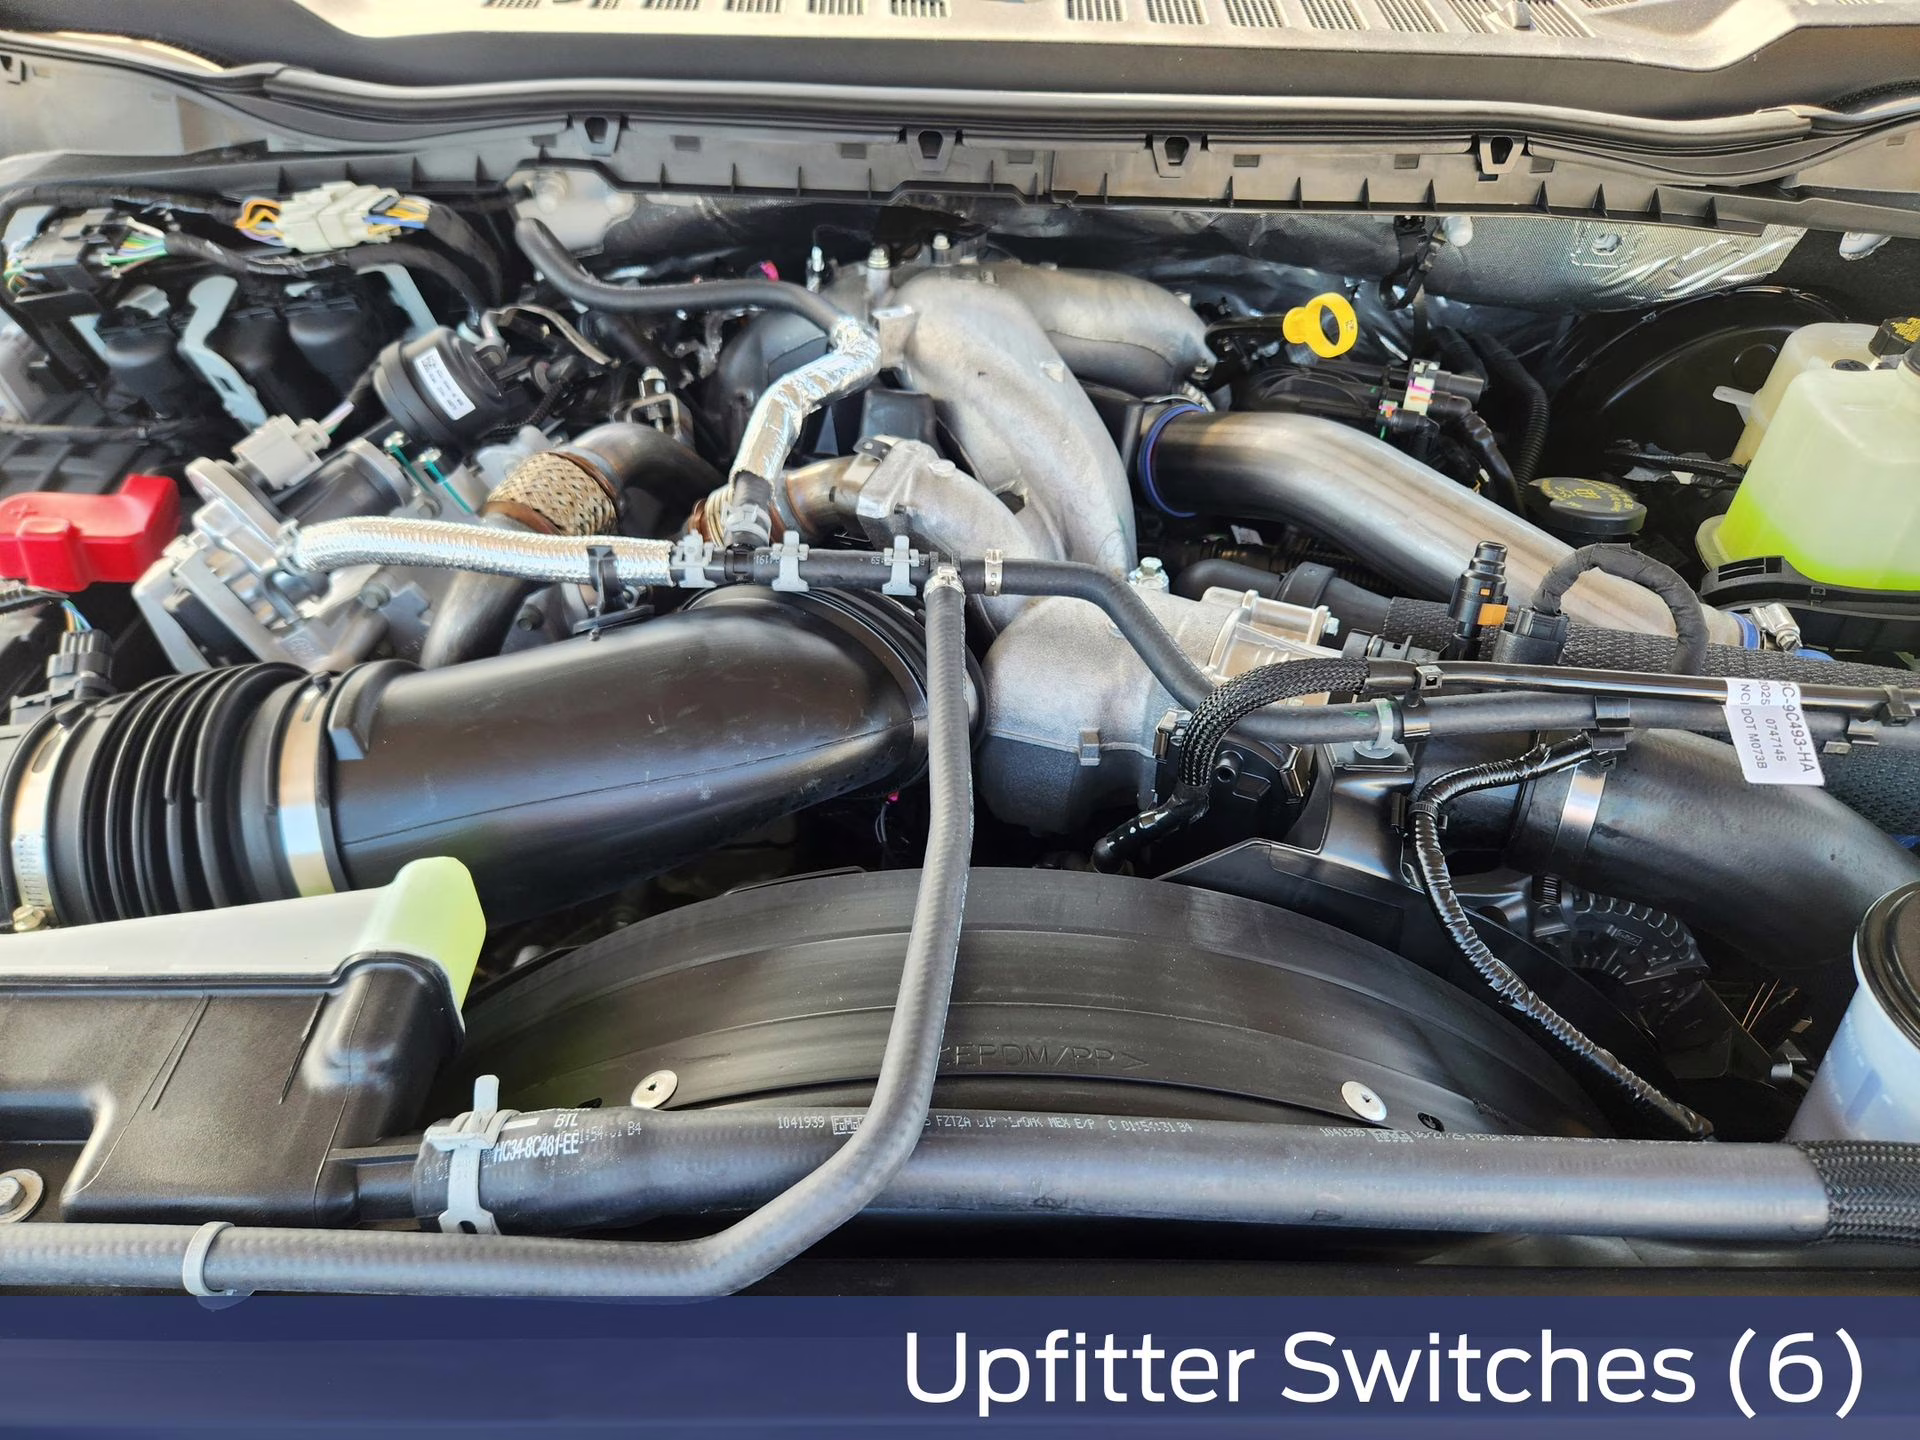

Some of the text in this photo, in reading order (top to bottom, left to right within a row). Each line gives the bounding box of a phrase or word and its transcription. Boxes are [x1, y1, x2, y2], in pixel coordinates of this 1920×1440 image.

[1741, 708, 1757, 730] DOT
[1765, 718, 1787, 761] 0747145
[1748, 733, 1768, 769] M073B
[554, 1112, 578, 1128] BTL
[778, 1115, 825, 1129] 1041939
